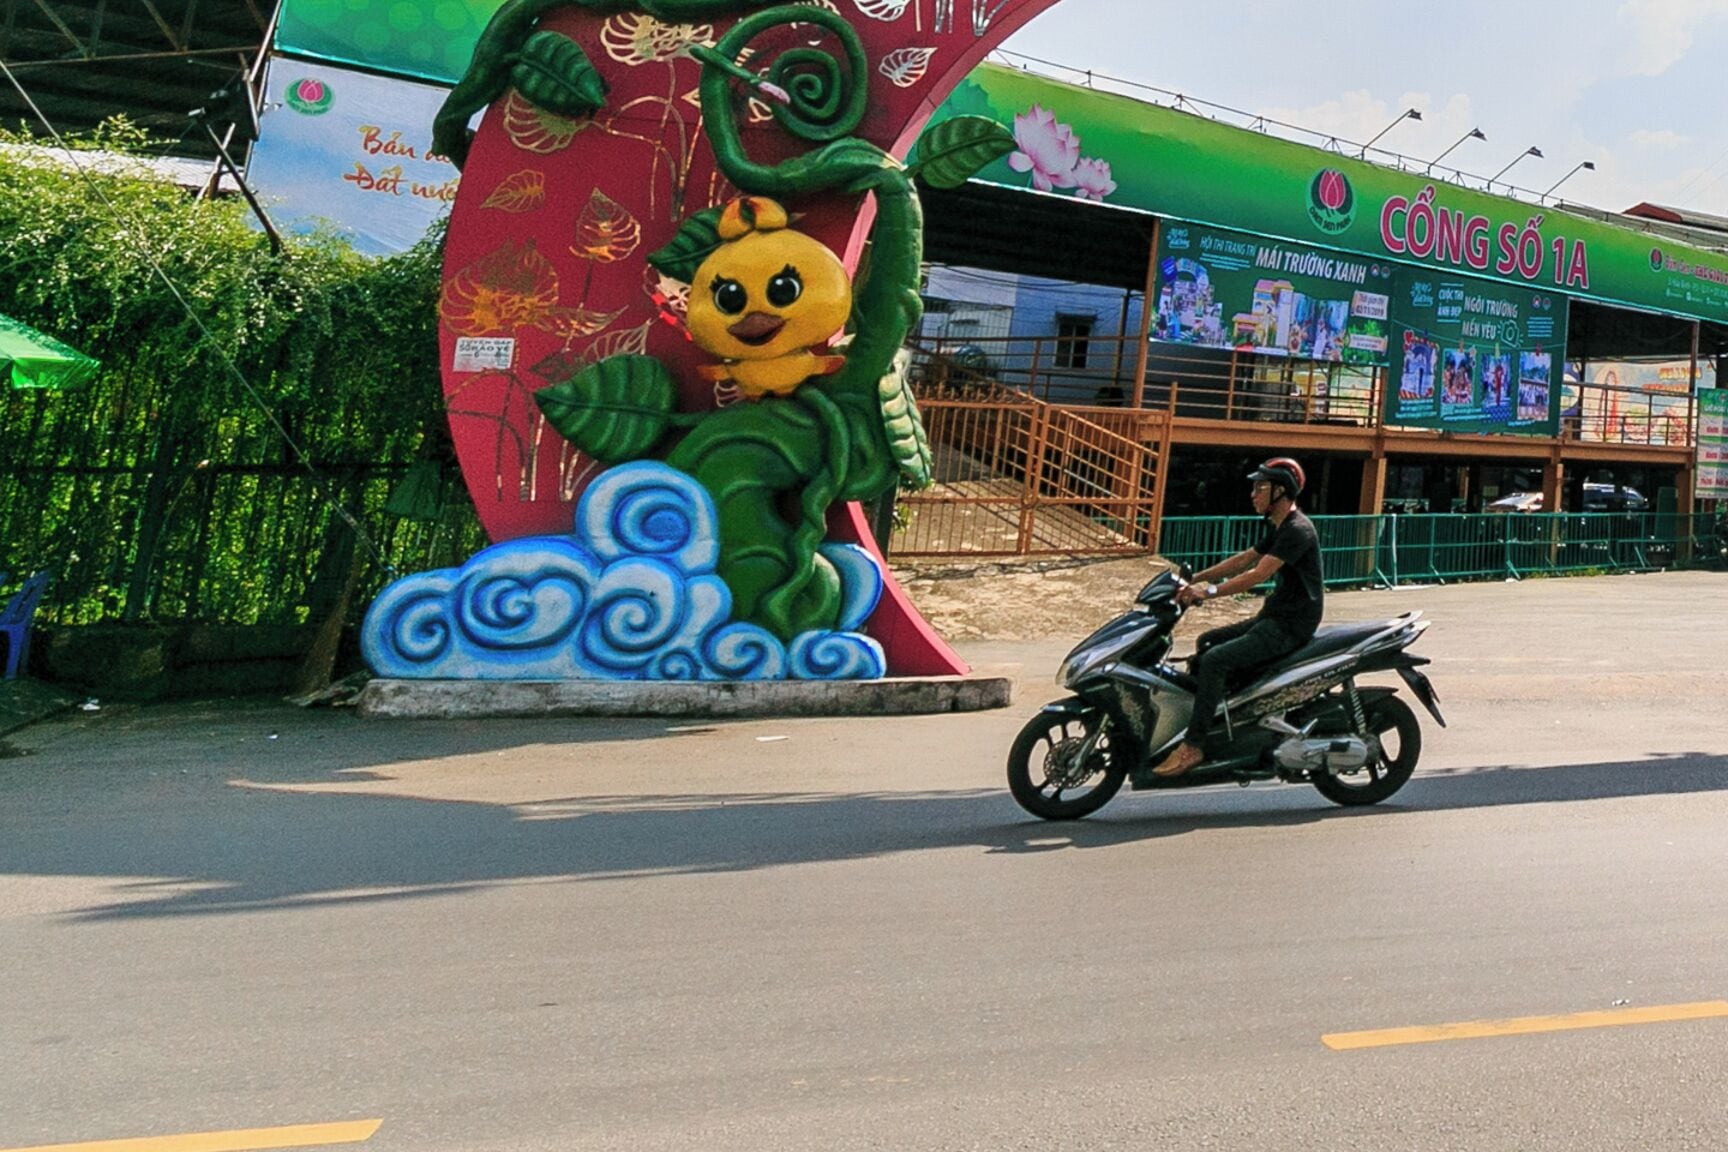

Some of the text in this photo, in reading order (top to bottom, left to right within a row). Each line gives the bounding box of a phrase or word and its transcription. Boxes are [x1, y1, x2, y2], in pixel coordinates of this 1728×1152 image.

[358, 125, 416, 159] Bản
[343, 162, 408, 196] Đất
[1380, 184, 1589, 290] CỔNG SỐ 1A
[1255, 245, 1280, 268] MÁI
[1285, 250, 1332, 279] TRƯỜNG
[1333, 261, 1367, 284] XANH
[1464, 295, 1518, 318] NGÔI TRƯỜNG
[1462, 317, 1497, 340] MẾN YÊU
